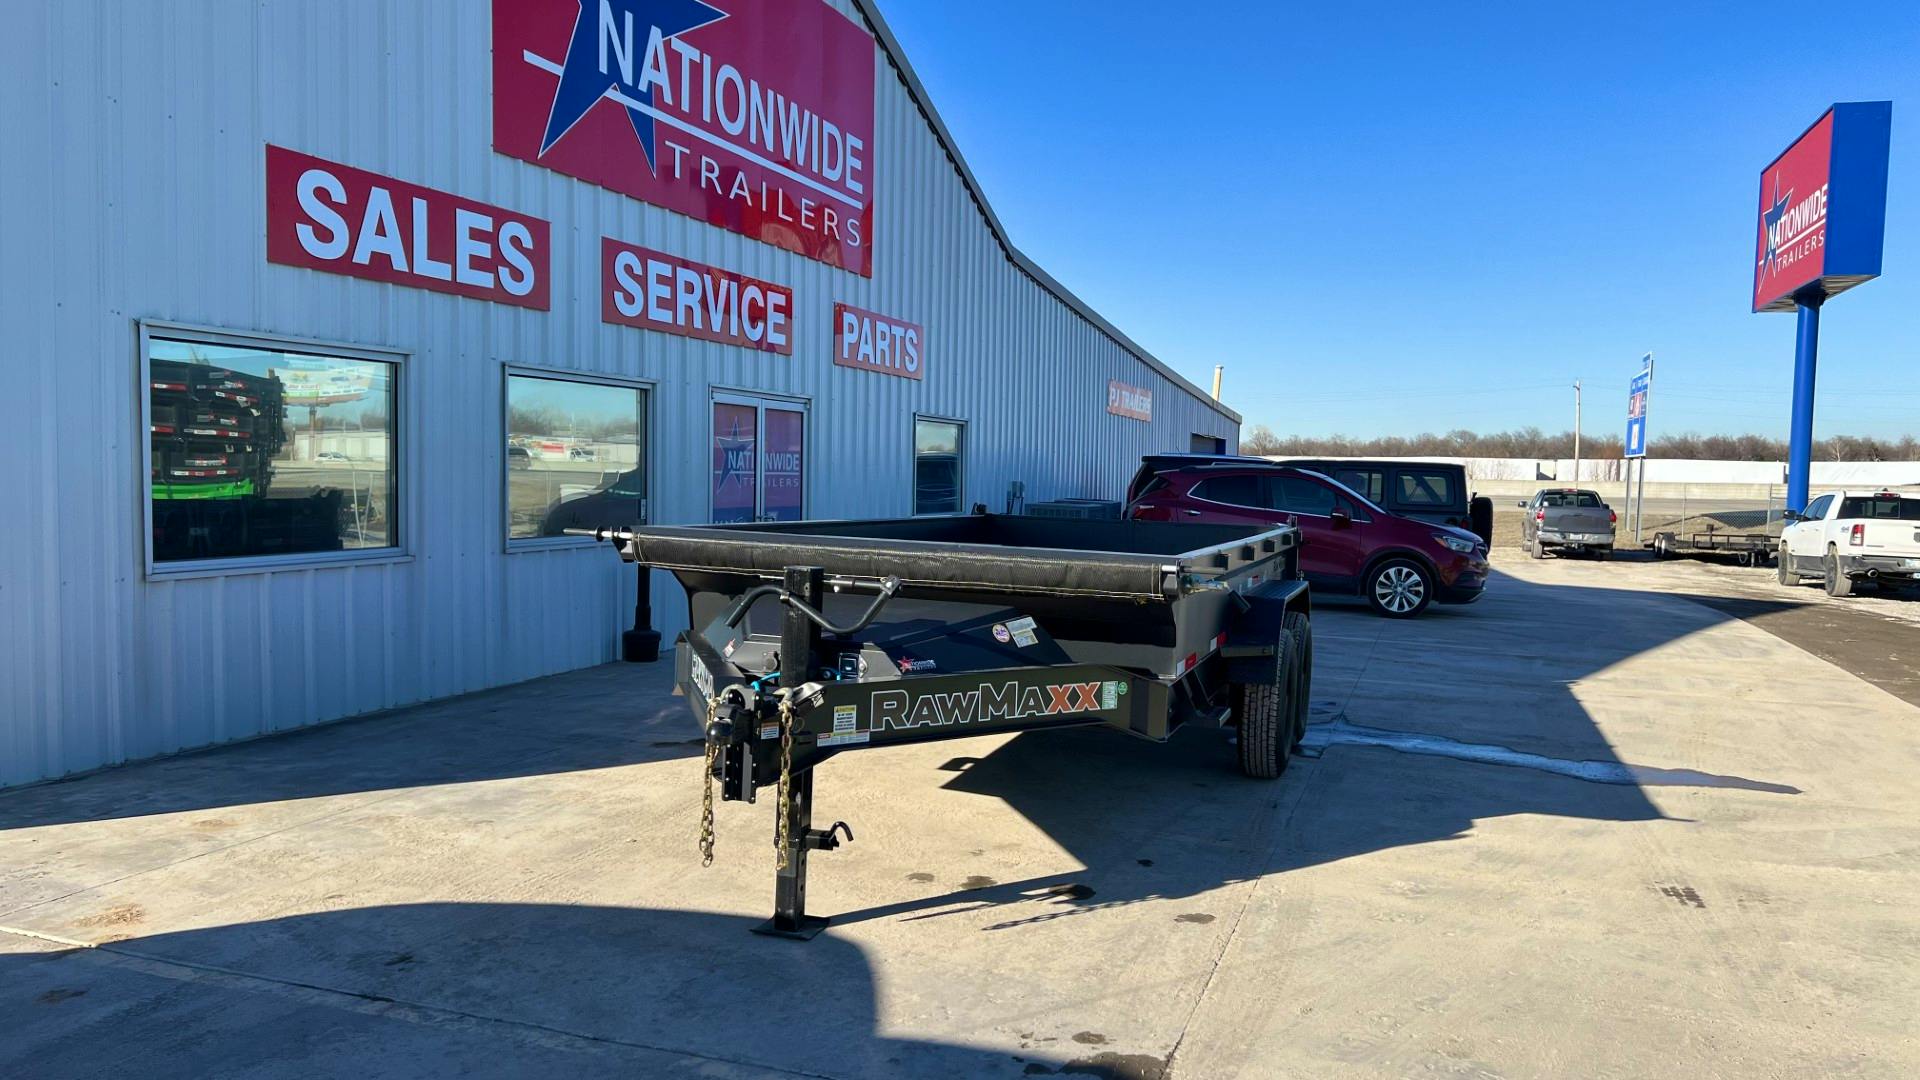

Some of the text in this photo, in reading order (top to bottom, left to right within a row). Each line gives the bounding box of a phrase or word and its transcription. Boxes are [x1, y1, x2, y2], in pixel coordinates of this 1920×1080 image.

[599, 0, 863, 195] NATIONWIDE
[665, 140, 861, 248] TRAILERS
[1768, 184, 1828, 251] NATIONWIDE
[295, 168, 535, 296] SALES
[1776, 229, 1825, 272] TRAILERS
[613, 250, 787, 347] SERVICE
[842, 311, 919, 373] PARTS
[728, 451, 799, 471] NATINWIDE
[744, 477, 799, 488] TRILERS
